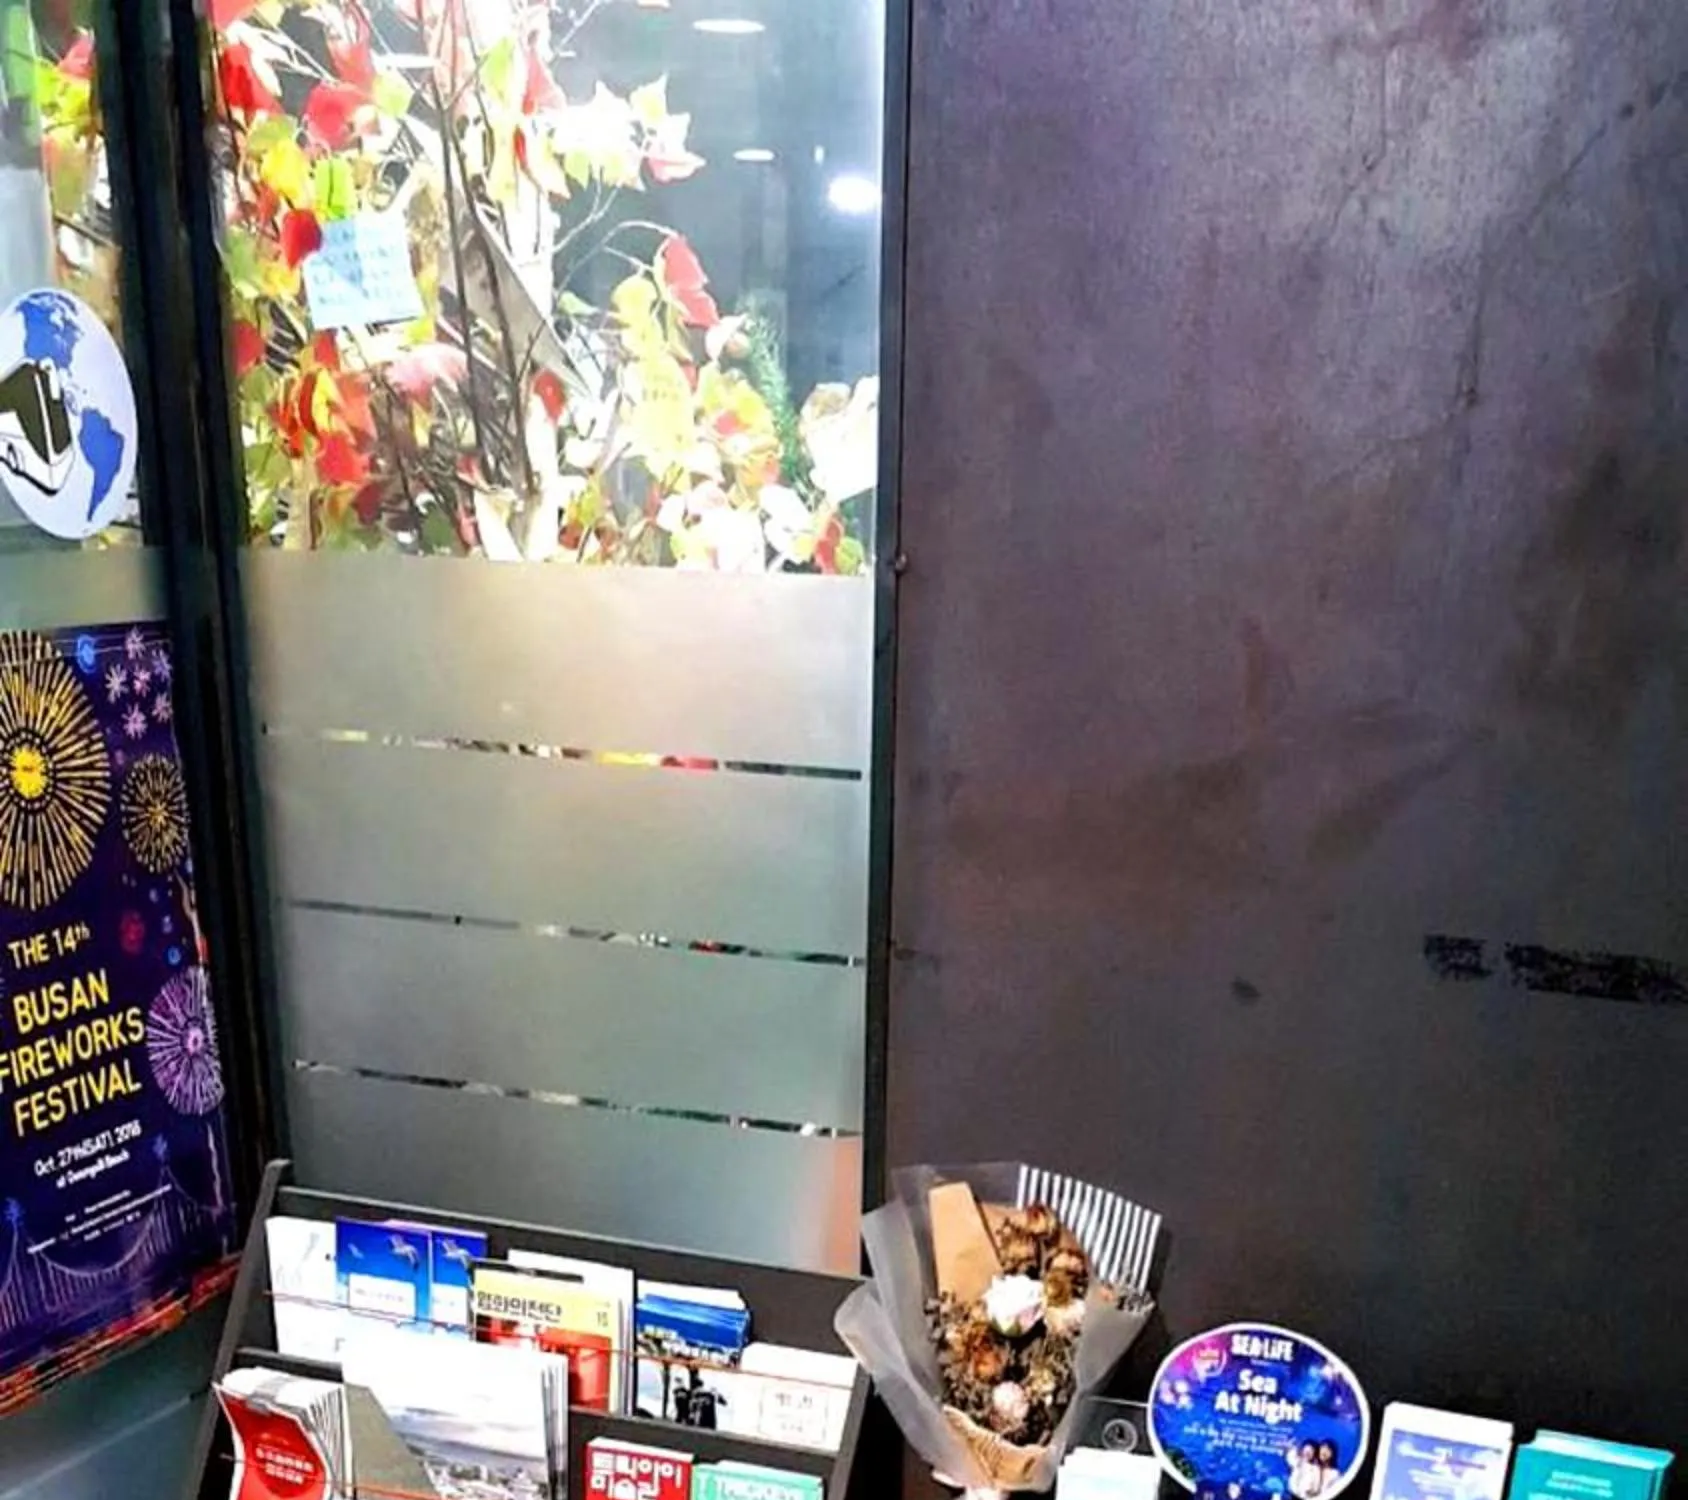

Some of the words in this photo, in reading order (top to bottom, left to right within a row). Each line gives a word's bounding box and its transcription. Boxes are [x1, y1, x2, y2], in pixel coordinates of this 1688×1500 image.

[7, 934, 50, 970] THE
[52, 920, 92, 957] 14th
[13, 966, 110, 1035] BUSAN
[0, 1006, 145, 1095] FIREWORKS
[14, 1057, 143, 1138] FESTIVAL
[1214, 1390, 1241, 1414] At
[1243, 1396, 1303, 1425] Night
[1237, 1368, 1278, 1395] Sea
